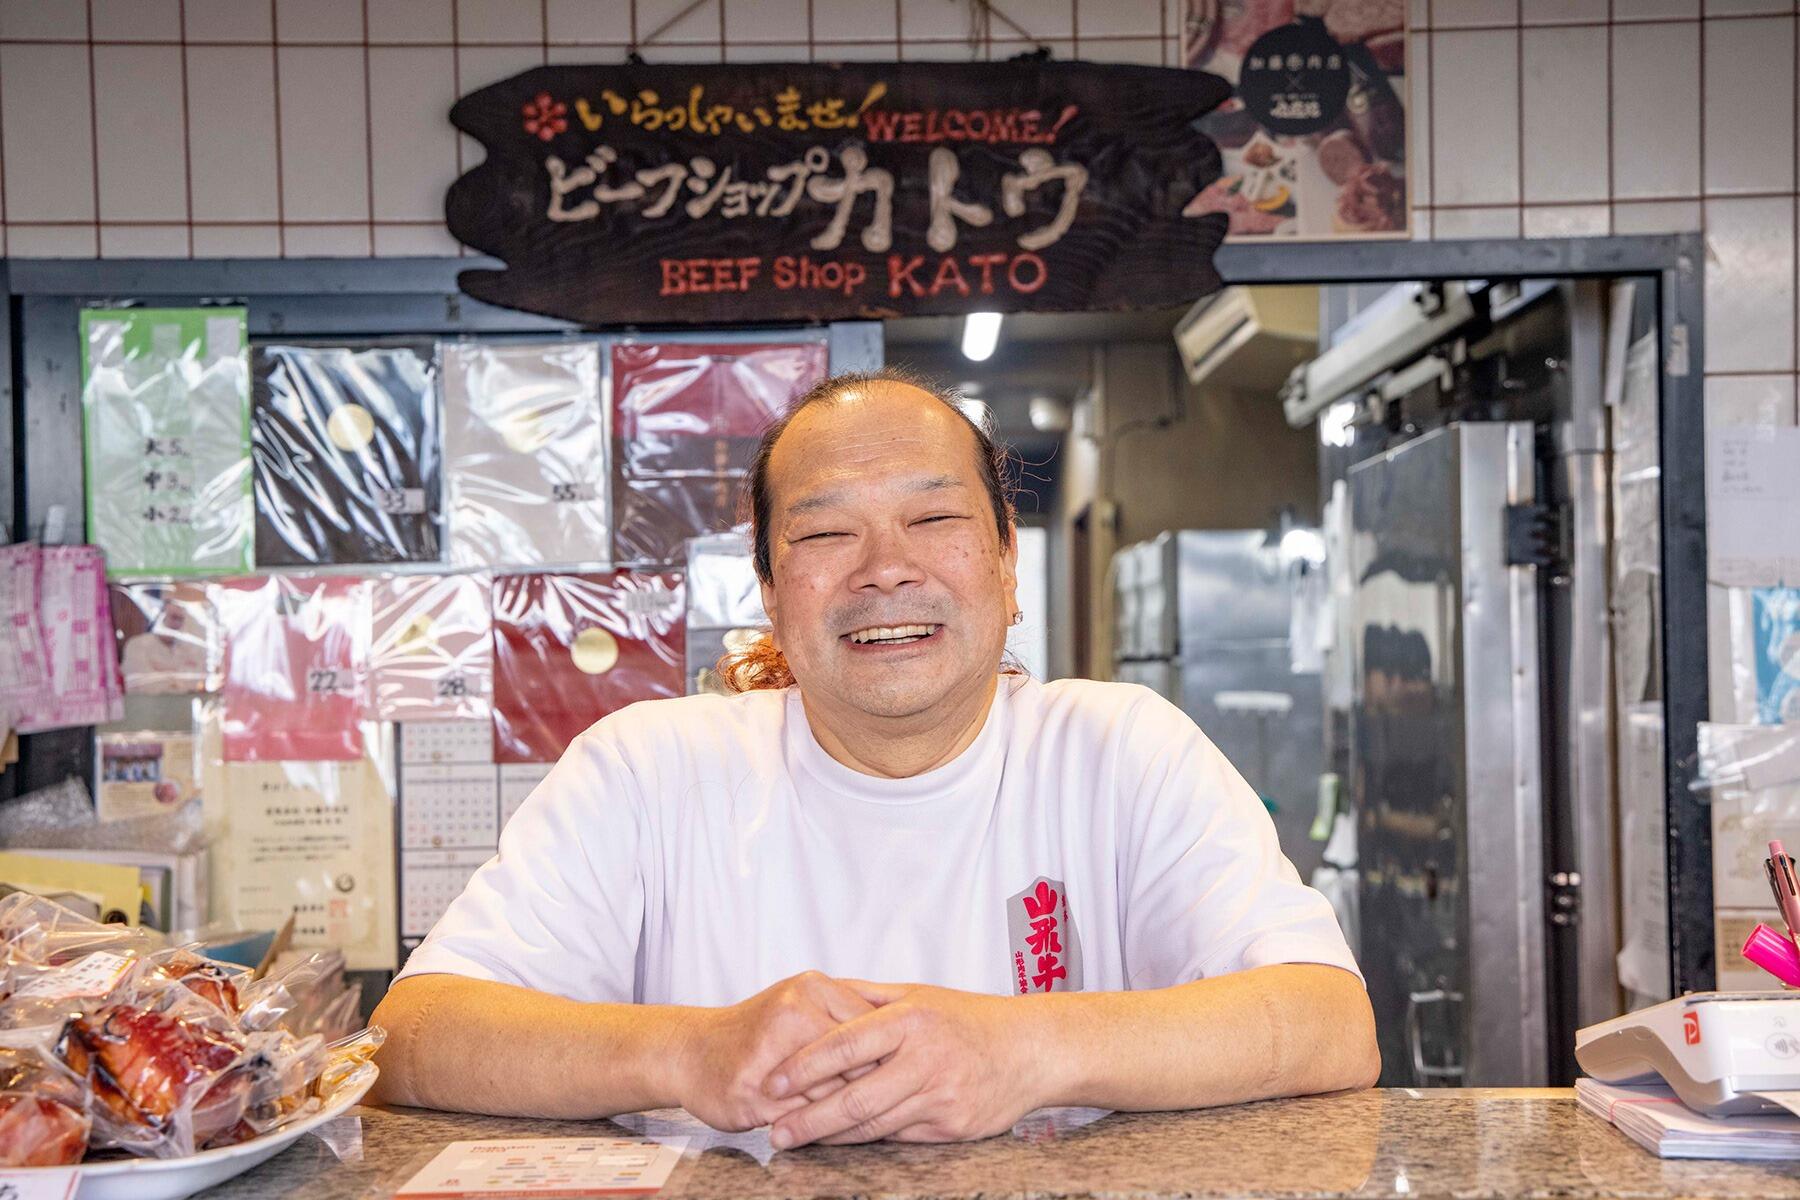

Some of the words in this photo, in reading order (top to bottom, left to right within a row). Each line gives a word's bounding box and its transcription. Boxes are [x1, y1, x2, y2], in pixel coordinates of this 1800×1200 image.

[861, 104, 1079, 143] WELCOME!
[659, 256, 761, 297] BEEF
[772, 255, 866, 295] Shop
[887, 253, 1048, 297] KATO
